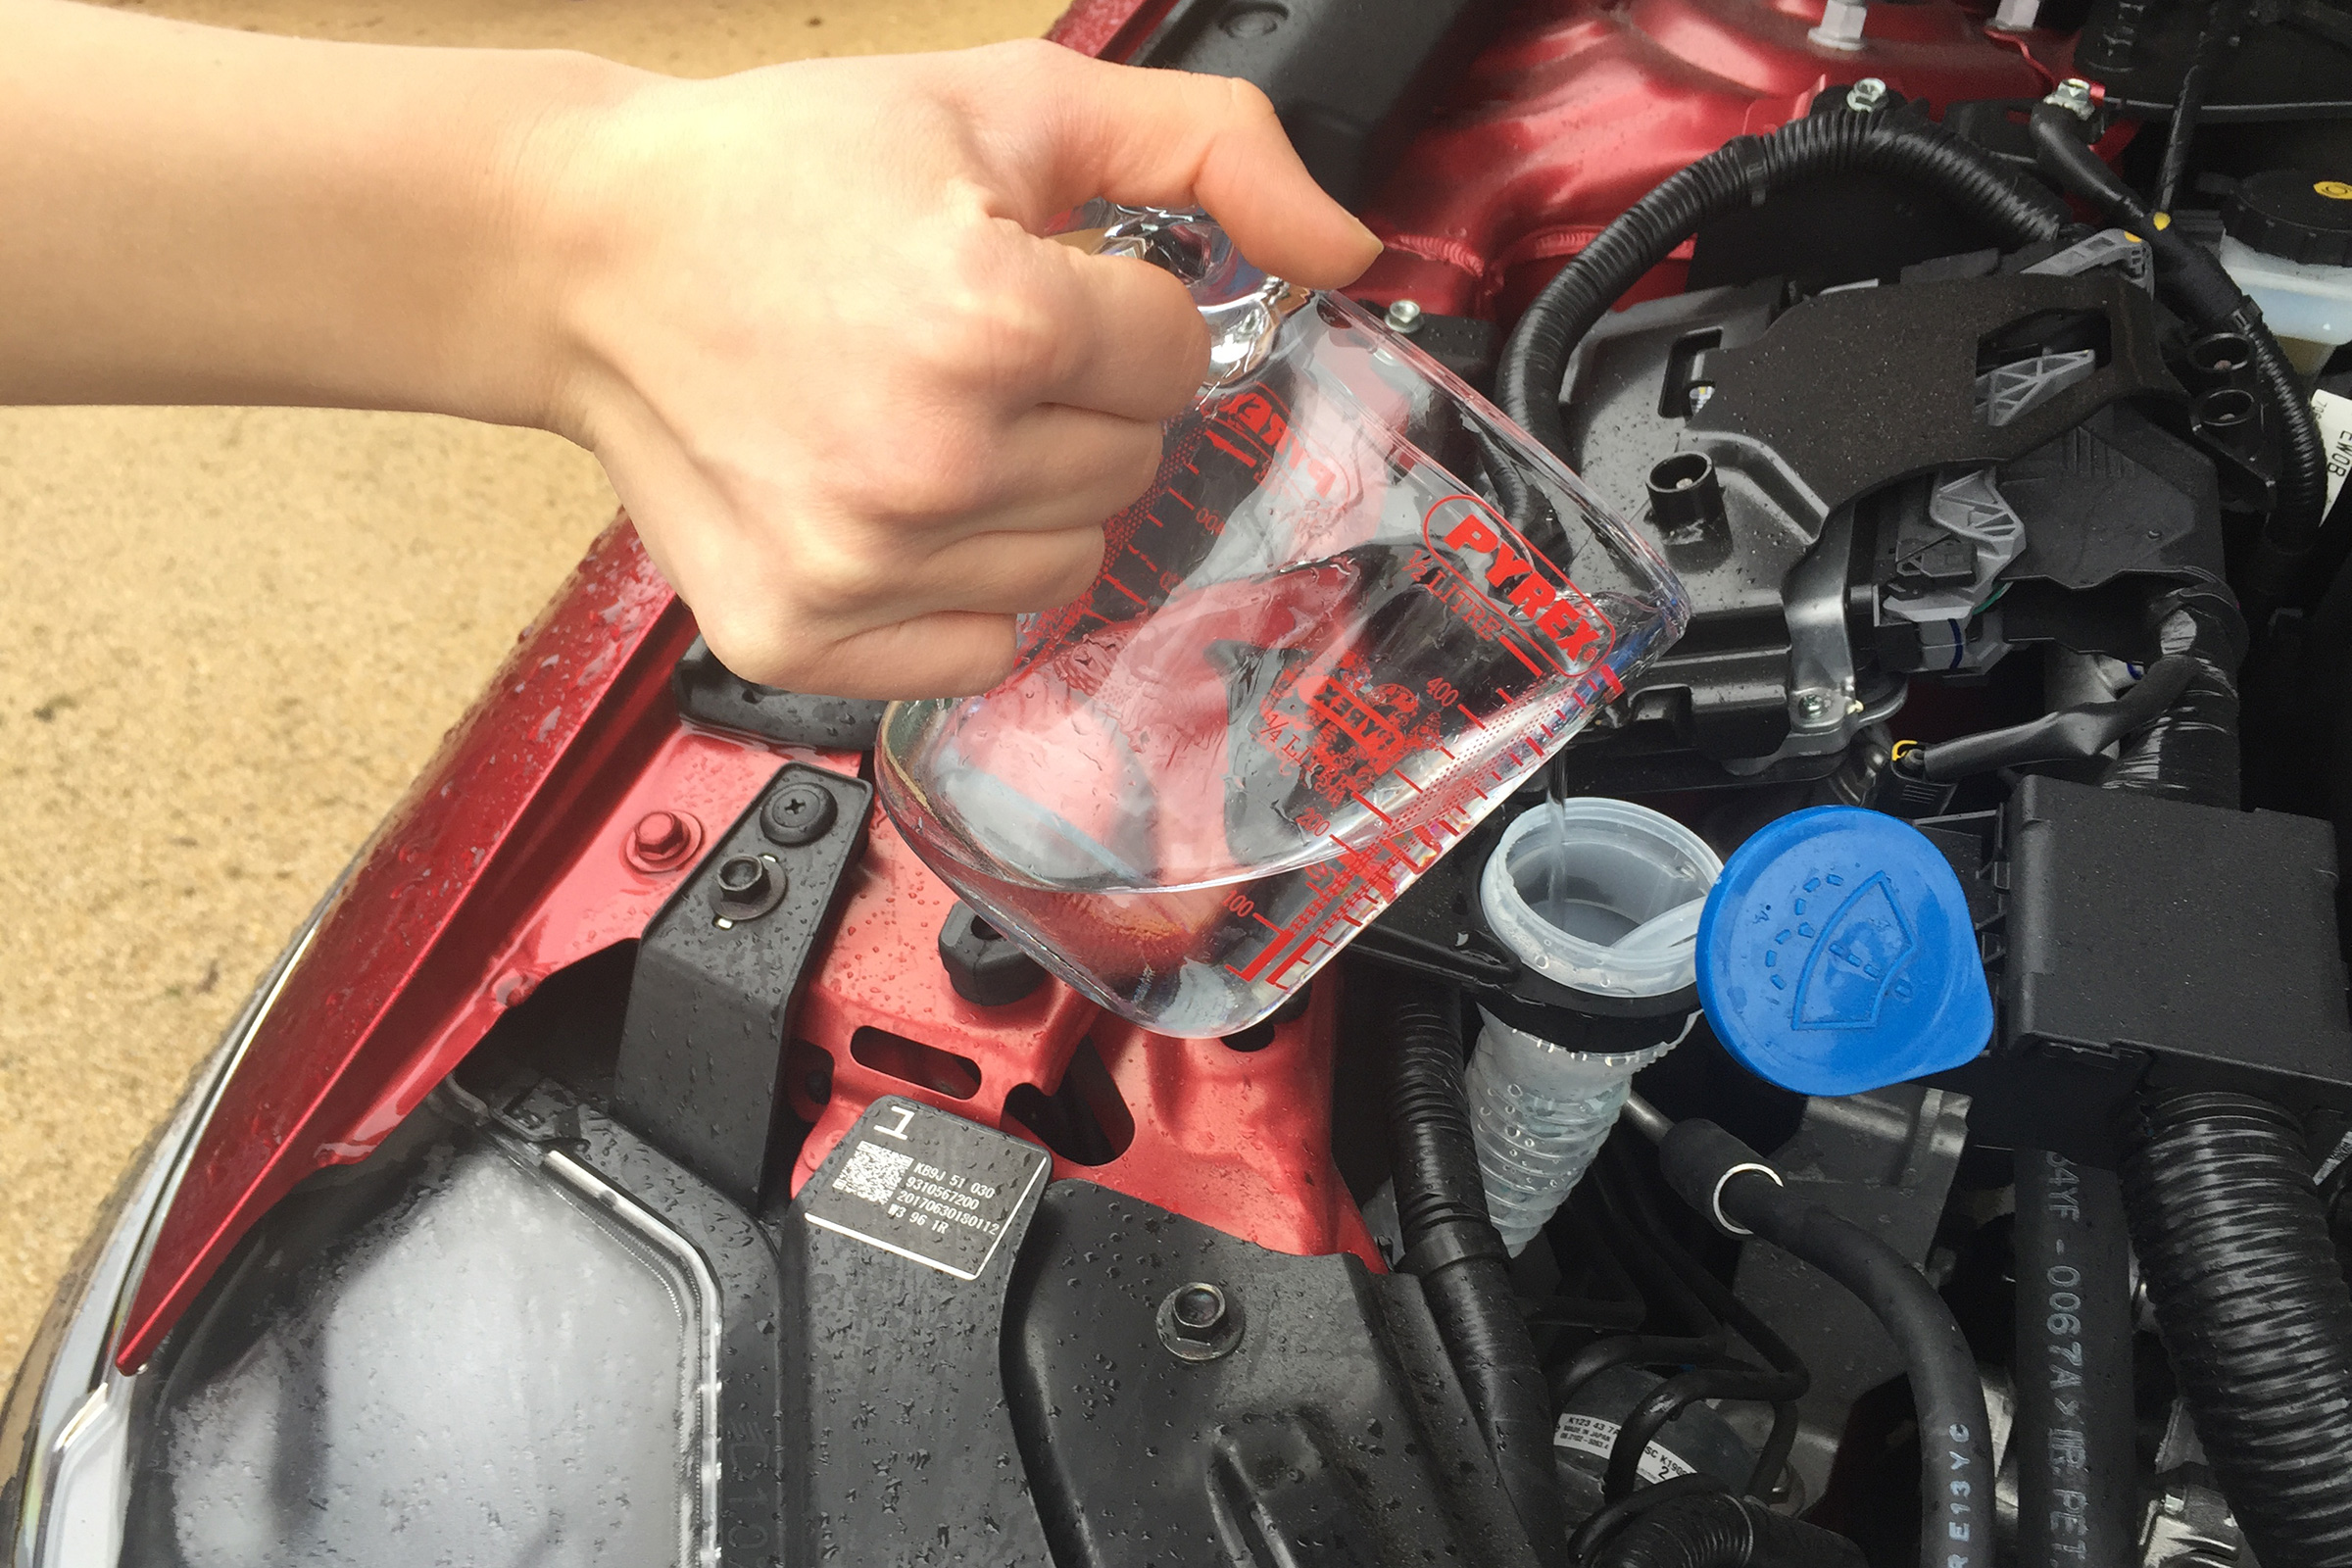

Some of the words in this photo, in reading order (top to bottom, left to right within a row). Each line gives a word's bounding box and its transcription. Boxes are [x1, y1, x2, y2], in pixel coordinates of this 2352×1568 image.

[1443, 514, 1602, 662] PYREX
[1425, 569, 1503, 642] LITRE
[1426, 676, 1459, 707] 400
[1296, 808, 1331, 837] 200
[1222, 890, 1255, 917] 100
[906, 1176, 980, 1210] 9310567200
[913, 1162, 947, 1182] KB9J
[949, 1175, 966, 1189] 51
[970, 1182, 996, 1199] 030
[896, 1190, 1000, 1236] 20170630180112
[908, 1211, 928, 1226] 96
[1590, 1431, 1611, 1443] JAPAN
[1592, 1421, 1606, 1432] 43
[1658, 1466, 1670, 1480] 2
